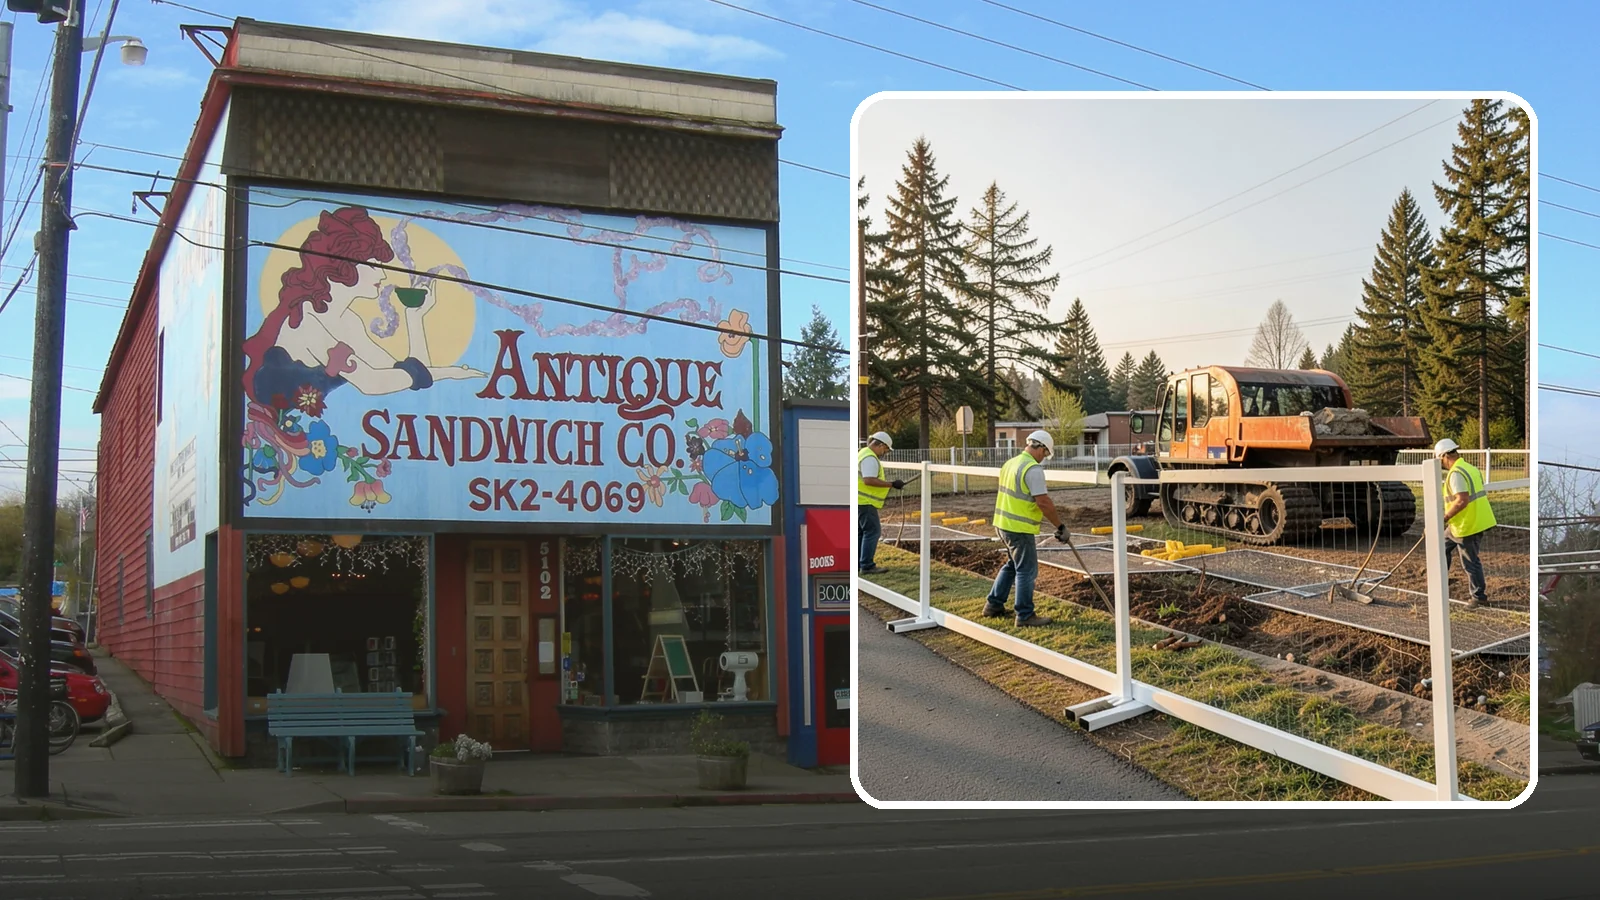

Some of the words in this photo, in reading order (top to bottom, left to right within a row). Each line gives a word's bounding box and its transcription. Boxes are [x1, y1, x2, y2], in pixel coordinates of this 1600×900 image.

[476, 329, 723, 421] ANTIQUE
[361, 409, 604, 467] SANDWICH
[617, 422, 684, 468] CO.
[469, 476, 645, 513] SK2-4069
[539, 542, 551, 599] 5102
[809, 555, 834, 569] BOOKS
